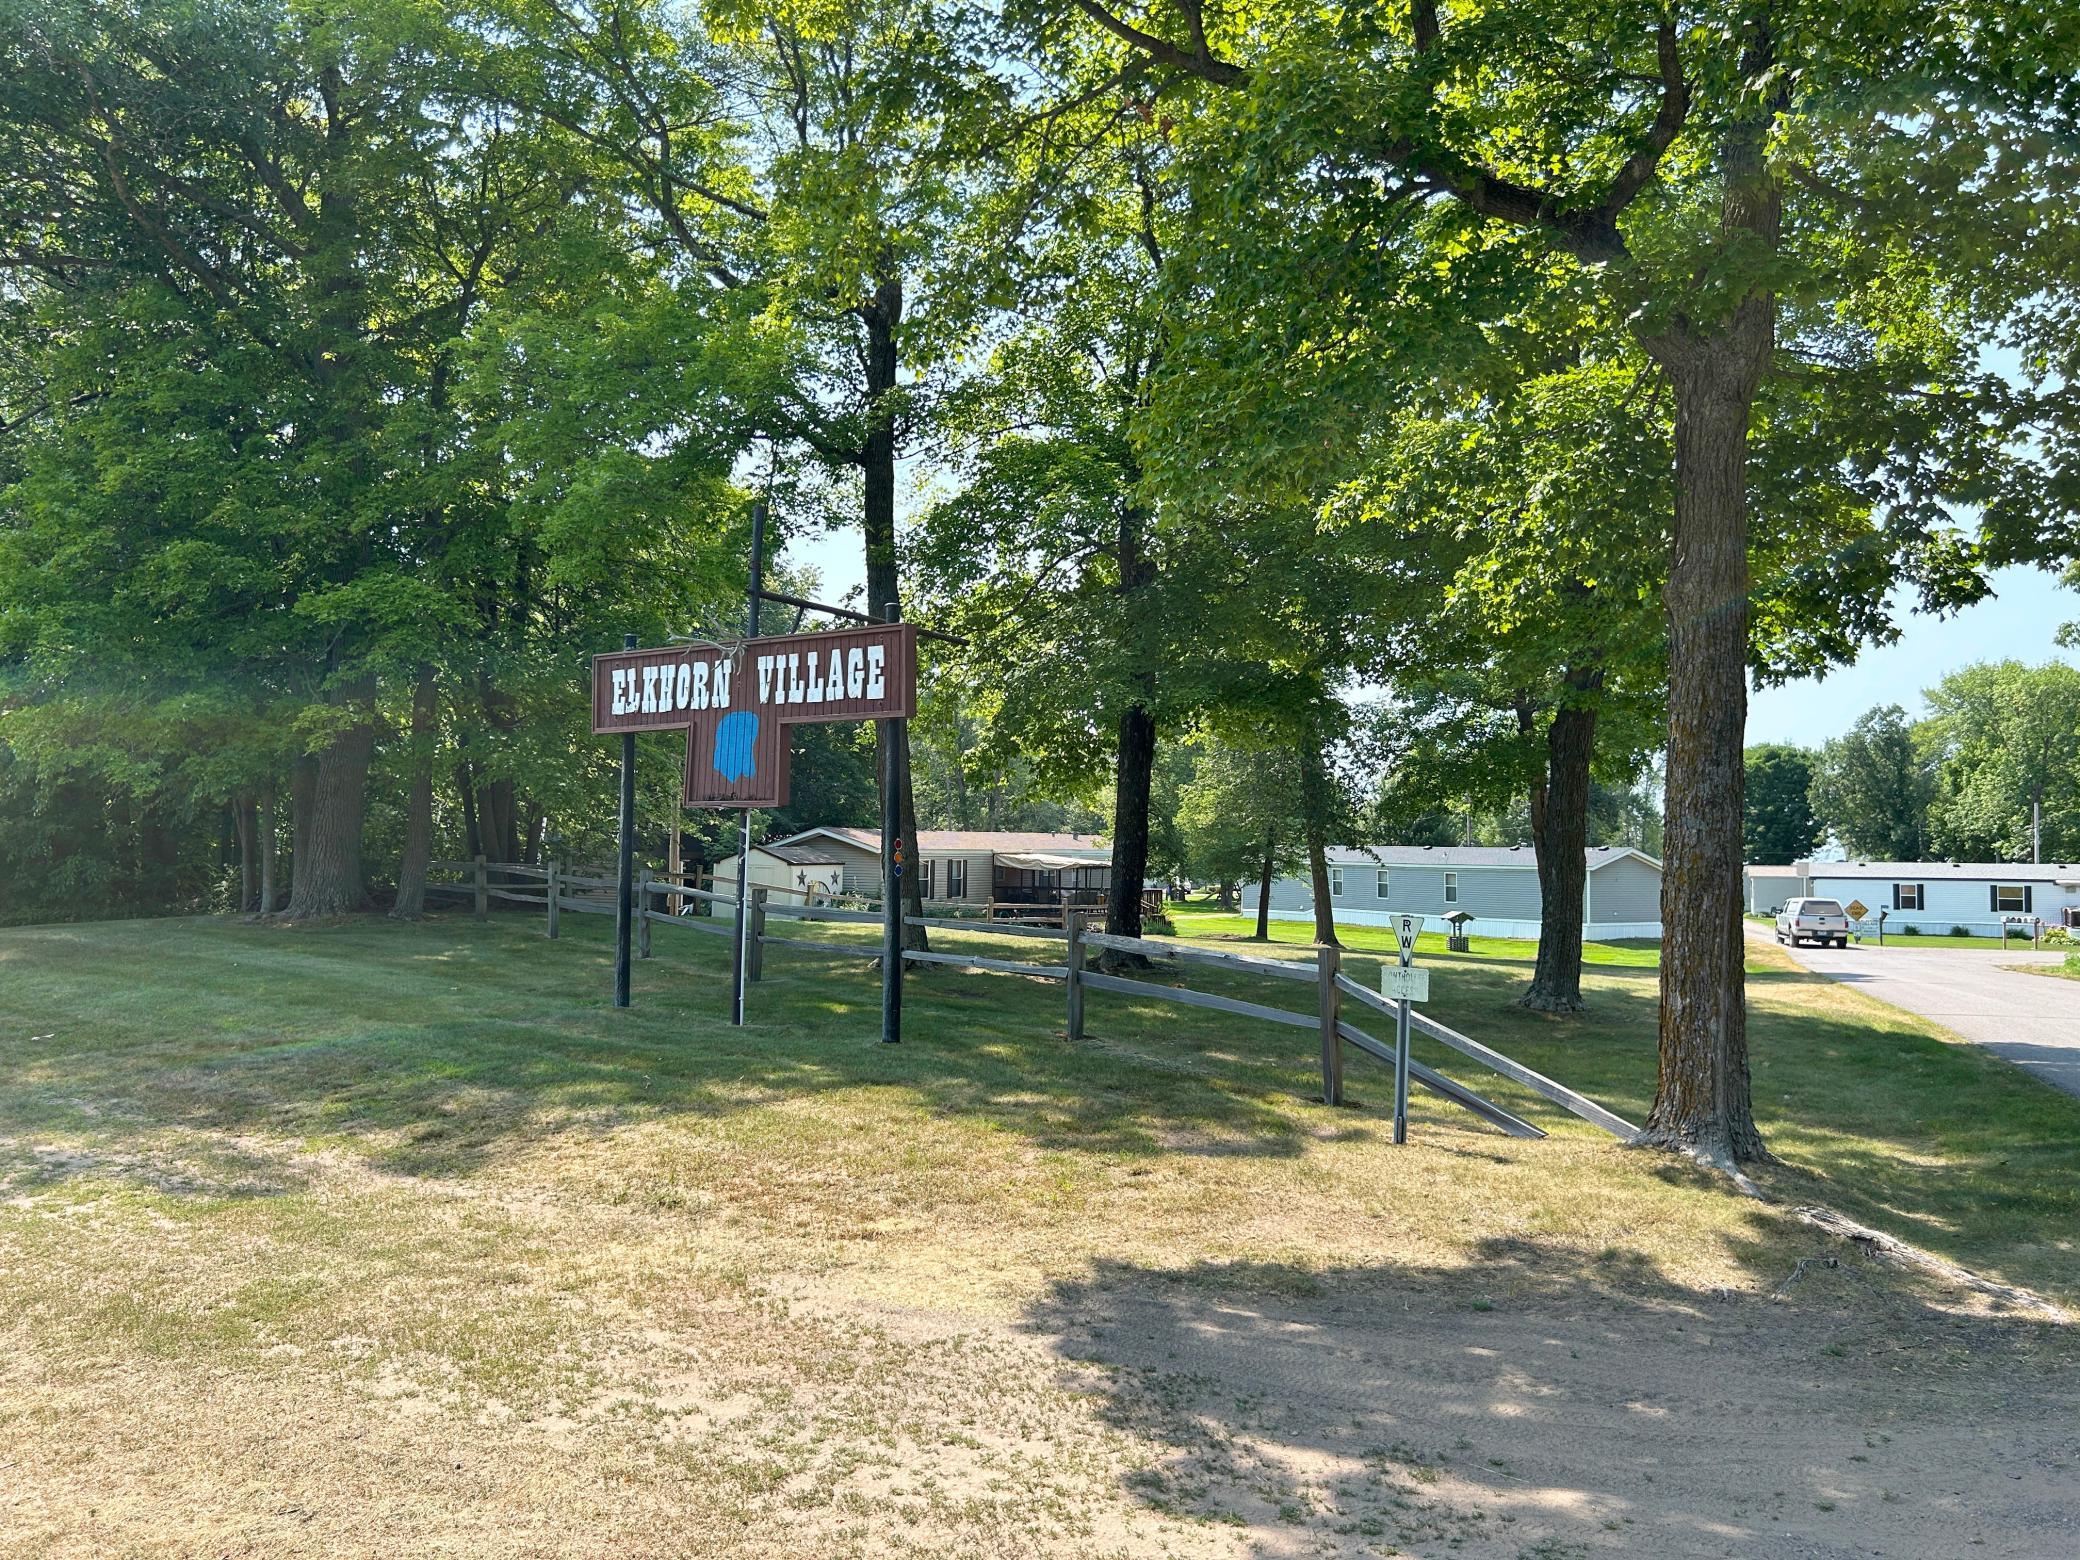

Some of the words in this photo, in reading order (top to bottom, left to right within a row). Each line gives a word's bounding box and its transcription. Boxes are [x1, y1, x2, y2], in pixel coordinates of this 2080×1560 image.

[611, 659, 732, 715] ELKHORN
[757, 645, 885, 705] VILLAGE
[1403, 919, 1411, 932] R
[1401, 935, 1412, 949] W
